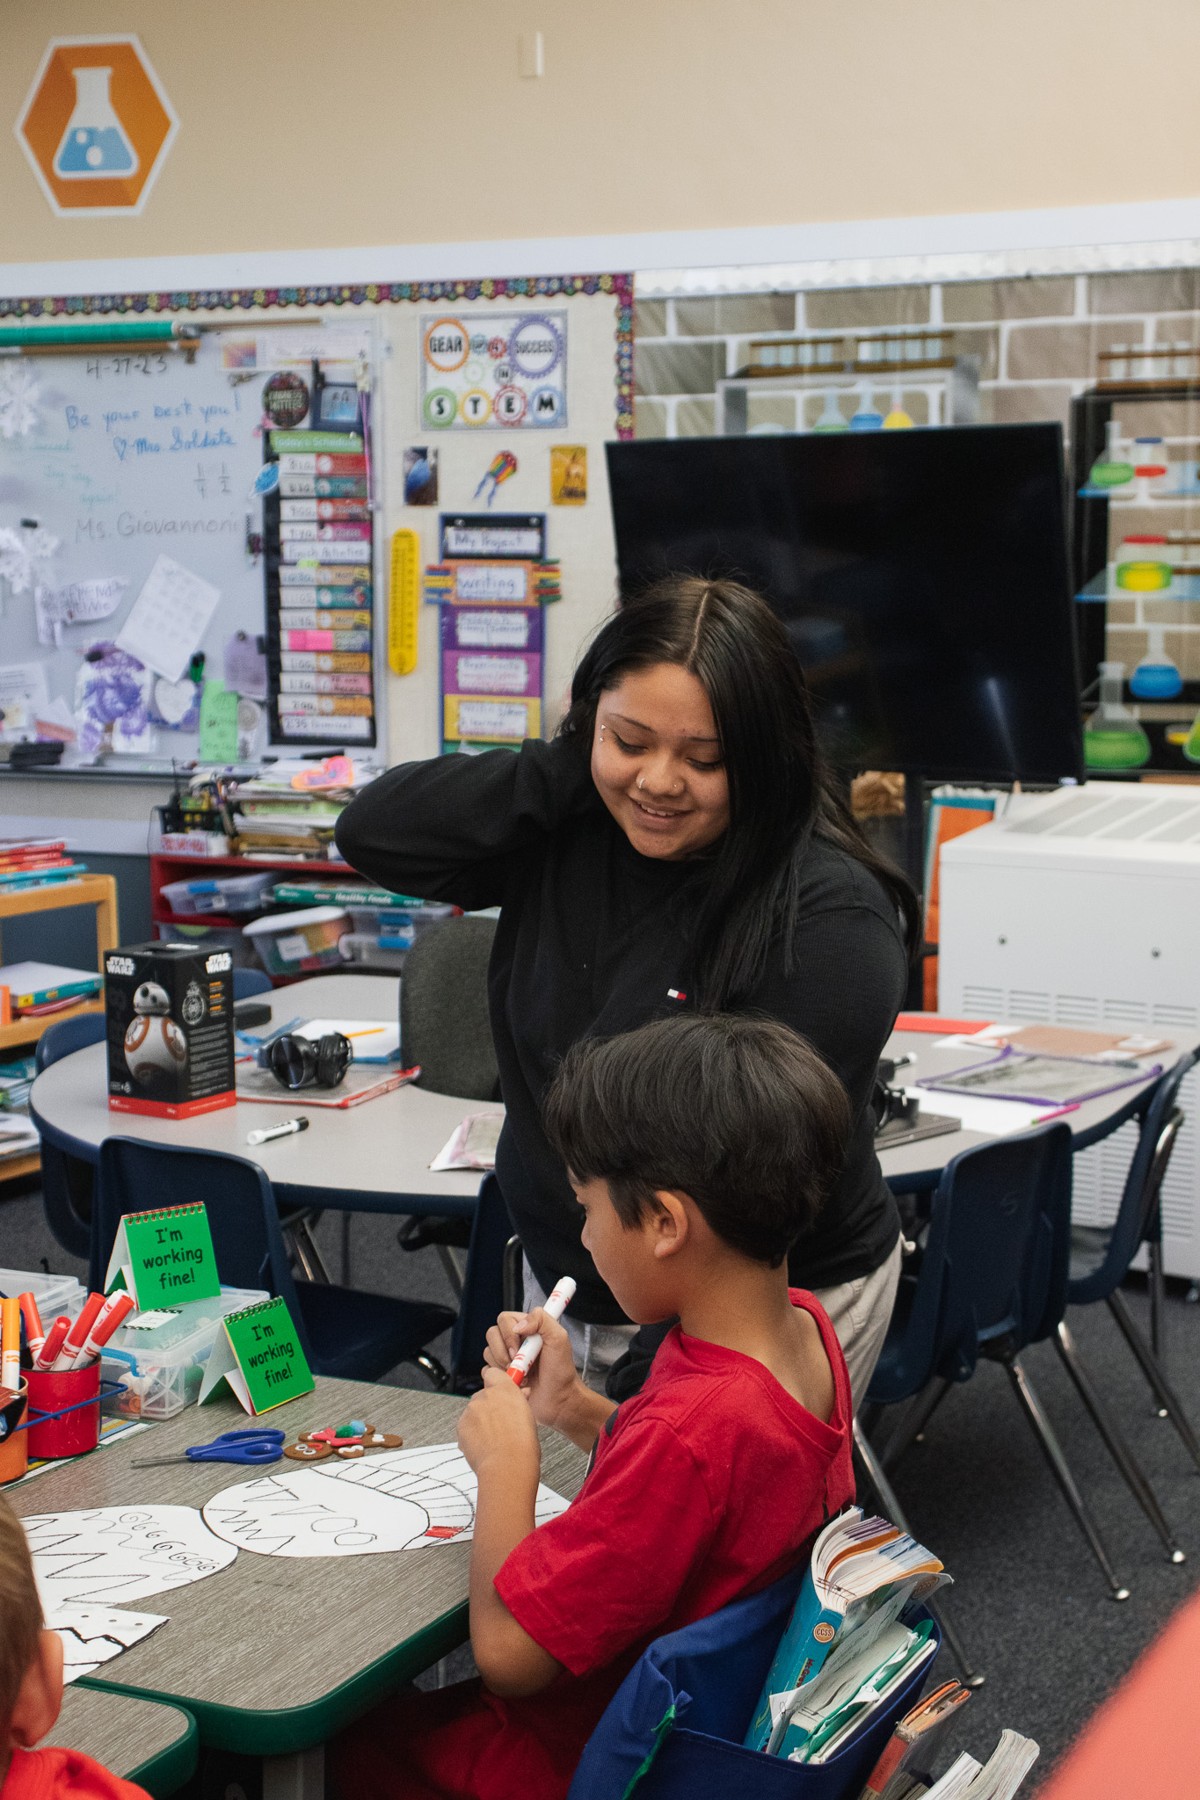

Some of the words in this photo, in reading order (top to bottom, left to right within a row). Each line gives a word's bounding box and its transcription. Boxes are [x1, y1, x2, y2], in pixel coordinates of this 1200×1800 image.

[429, 336, 463, 353] GEAR
[515, 340, 554, 354] SUCCESS
[65, 405, 90, 430] Be
[102, 409, 141, 433] your
[335, 892, 366, 904] Healthy
[106, 955, 133, 966] STAR
[208, 952, 232, 963] STAR
[107, 965, 134, 976] WARS
[205, 962, 232, 975] WARS
[155, 1227, 183, 1245] I'm
[142, 1247, 204, 1270] working
[159, 1267, 196, 1290] fine!
[251, 1323, 275, 1342] I'm
[247, 1341, 295, 1369] working
[264, 1363, 294, 1388] fine!
[816, 1627, 833, 1637] CCSS
